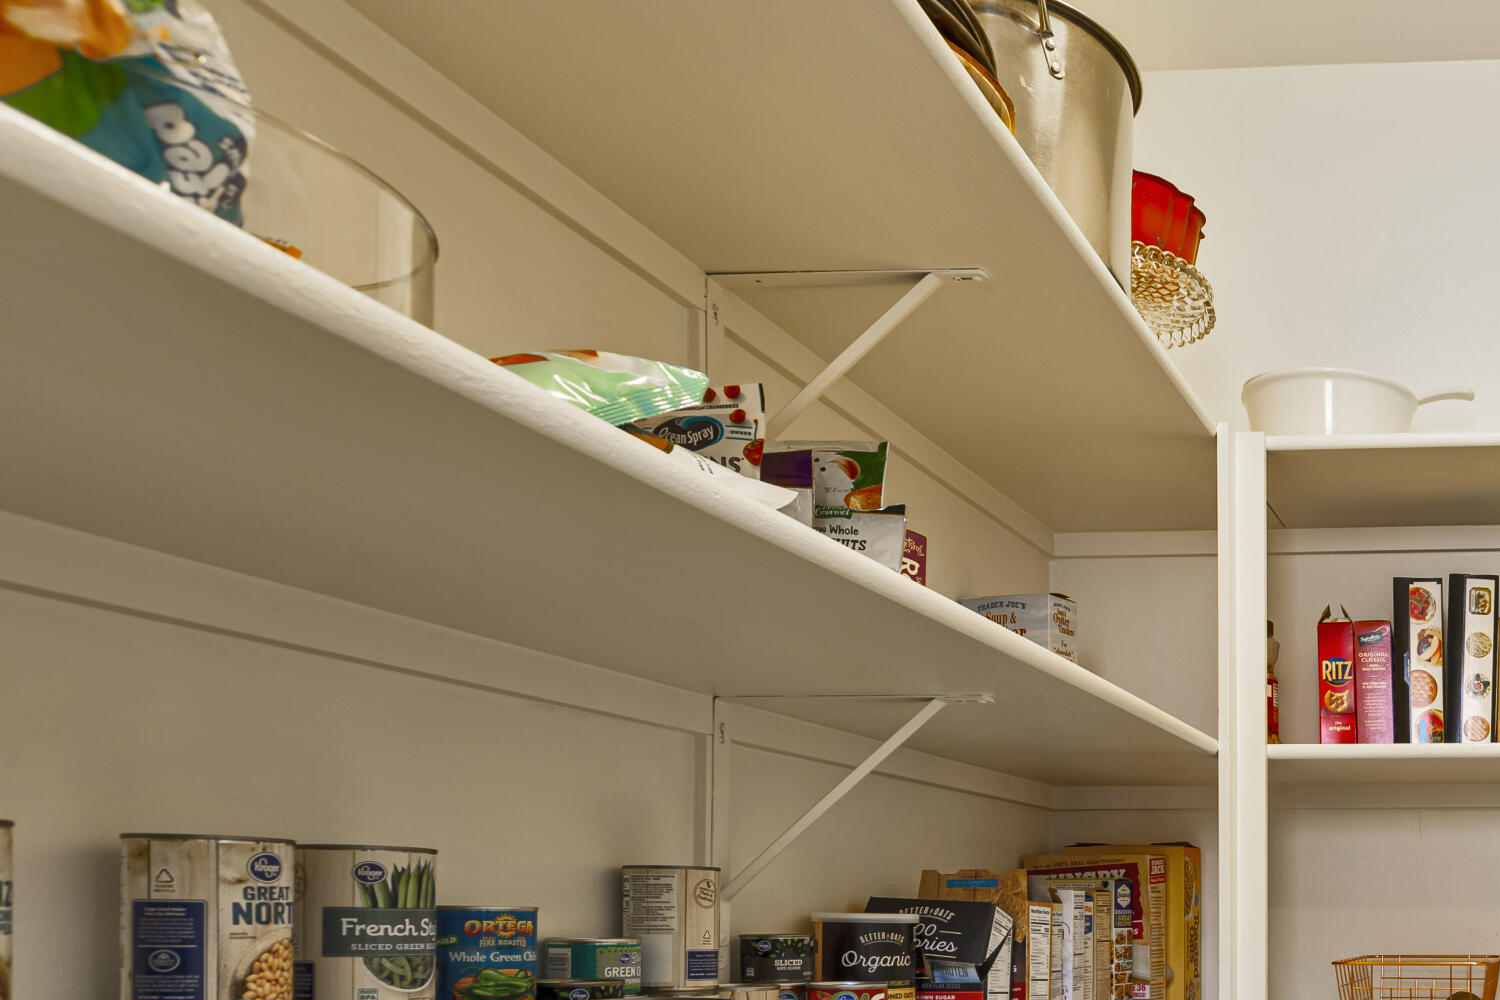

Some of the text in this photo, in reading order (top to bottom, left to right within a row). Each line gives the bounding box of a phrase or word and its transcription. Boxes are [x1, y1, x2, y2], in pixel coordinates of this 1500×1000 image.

[660, 426, 715, 445] Ocean Spray
[829, 525, 859, 535] Whole
[977, 602, 1004, 612] TRADER
[1322, 660, 1353, 681] RITZ
[253, 858, 281, 878] Kroger
[242, 885, 291, 902] GREAT
[232, 901, 293, 926] NORT
[340, 916, 419, 937] French
[464, 918, 534, 937] ORTEGA
[351, 943, 392, 951] SLICED
[395, 943, 425, 951] GREEN
[889, 932, 905, 944] OATS
[449, 951, 522, 963] Whole Green
[842, 950, 911, 973] Organic
[604, 966, 635, 977] GREEN
